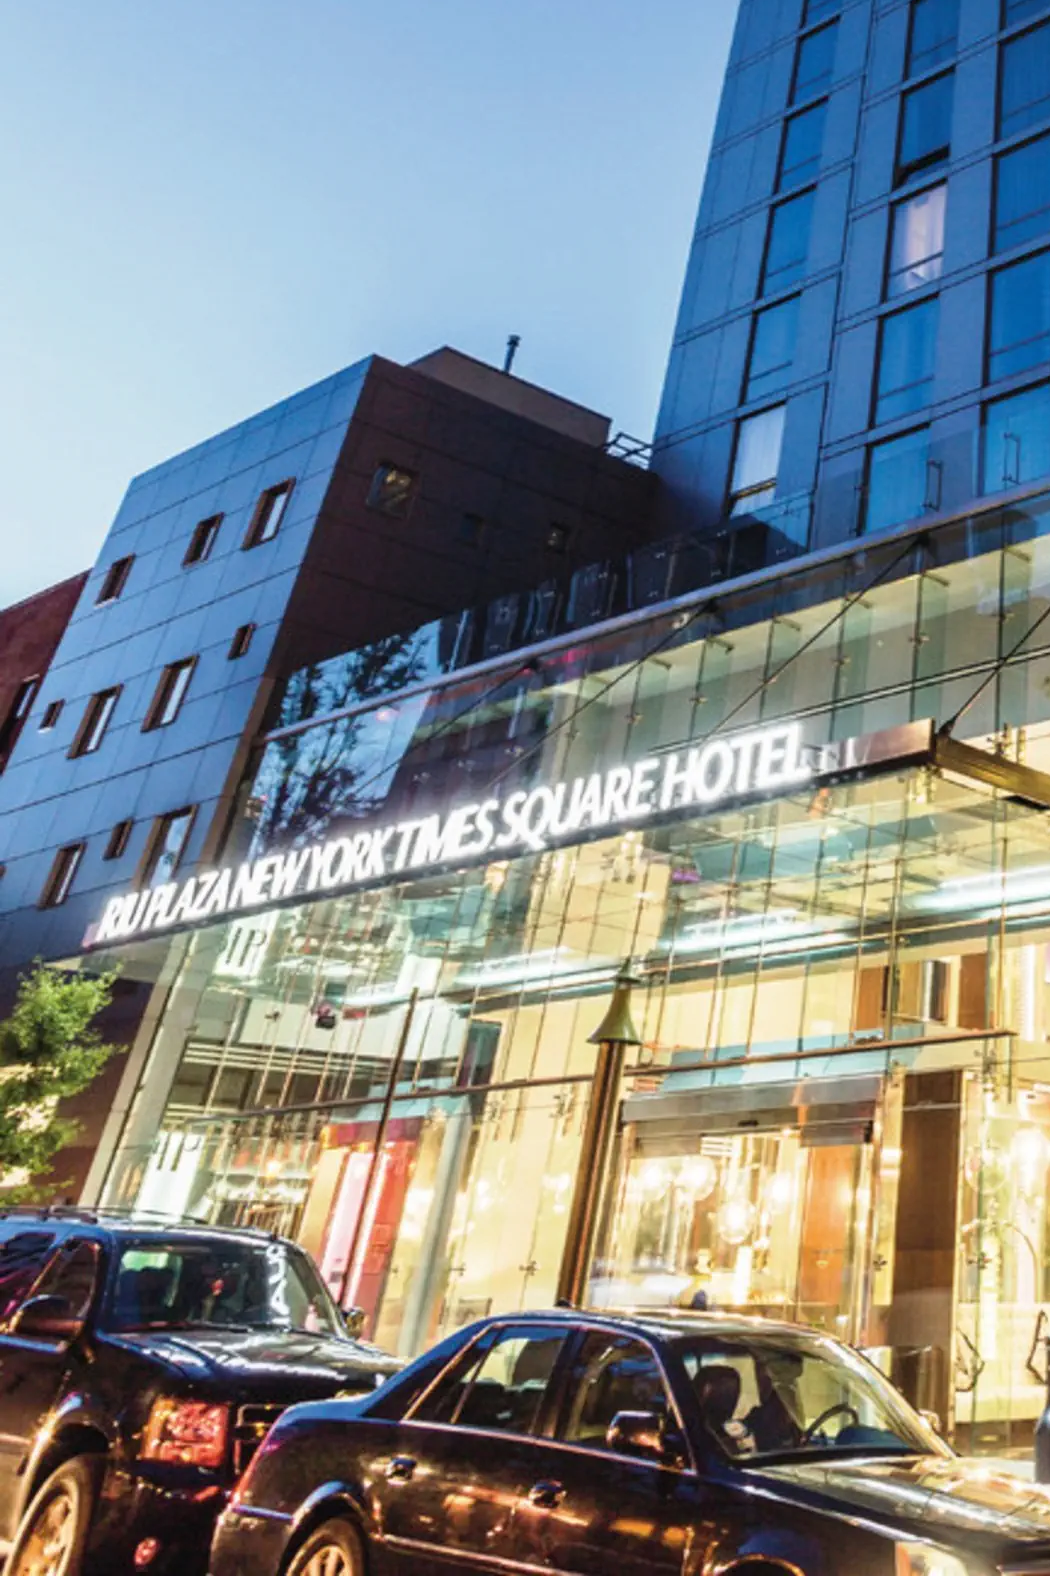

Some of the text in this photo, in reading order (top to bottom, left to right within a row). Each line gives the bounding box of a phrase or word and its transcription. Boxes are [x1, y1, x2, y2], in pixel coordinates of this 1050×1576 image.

[100, 722, 812, 938] RIU PLAZA NEW YORK TIMES SQUARE HOTEL
